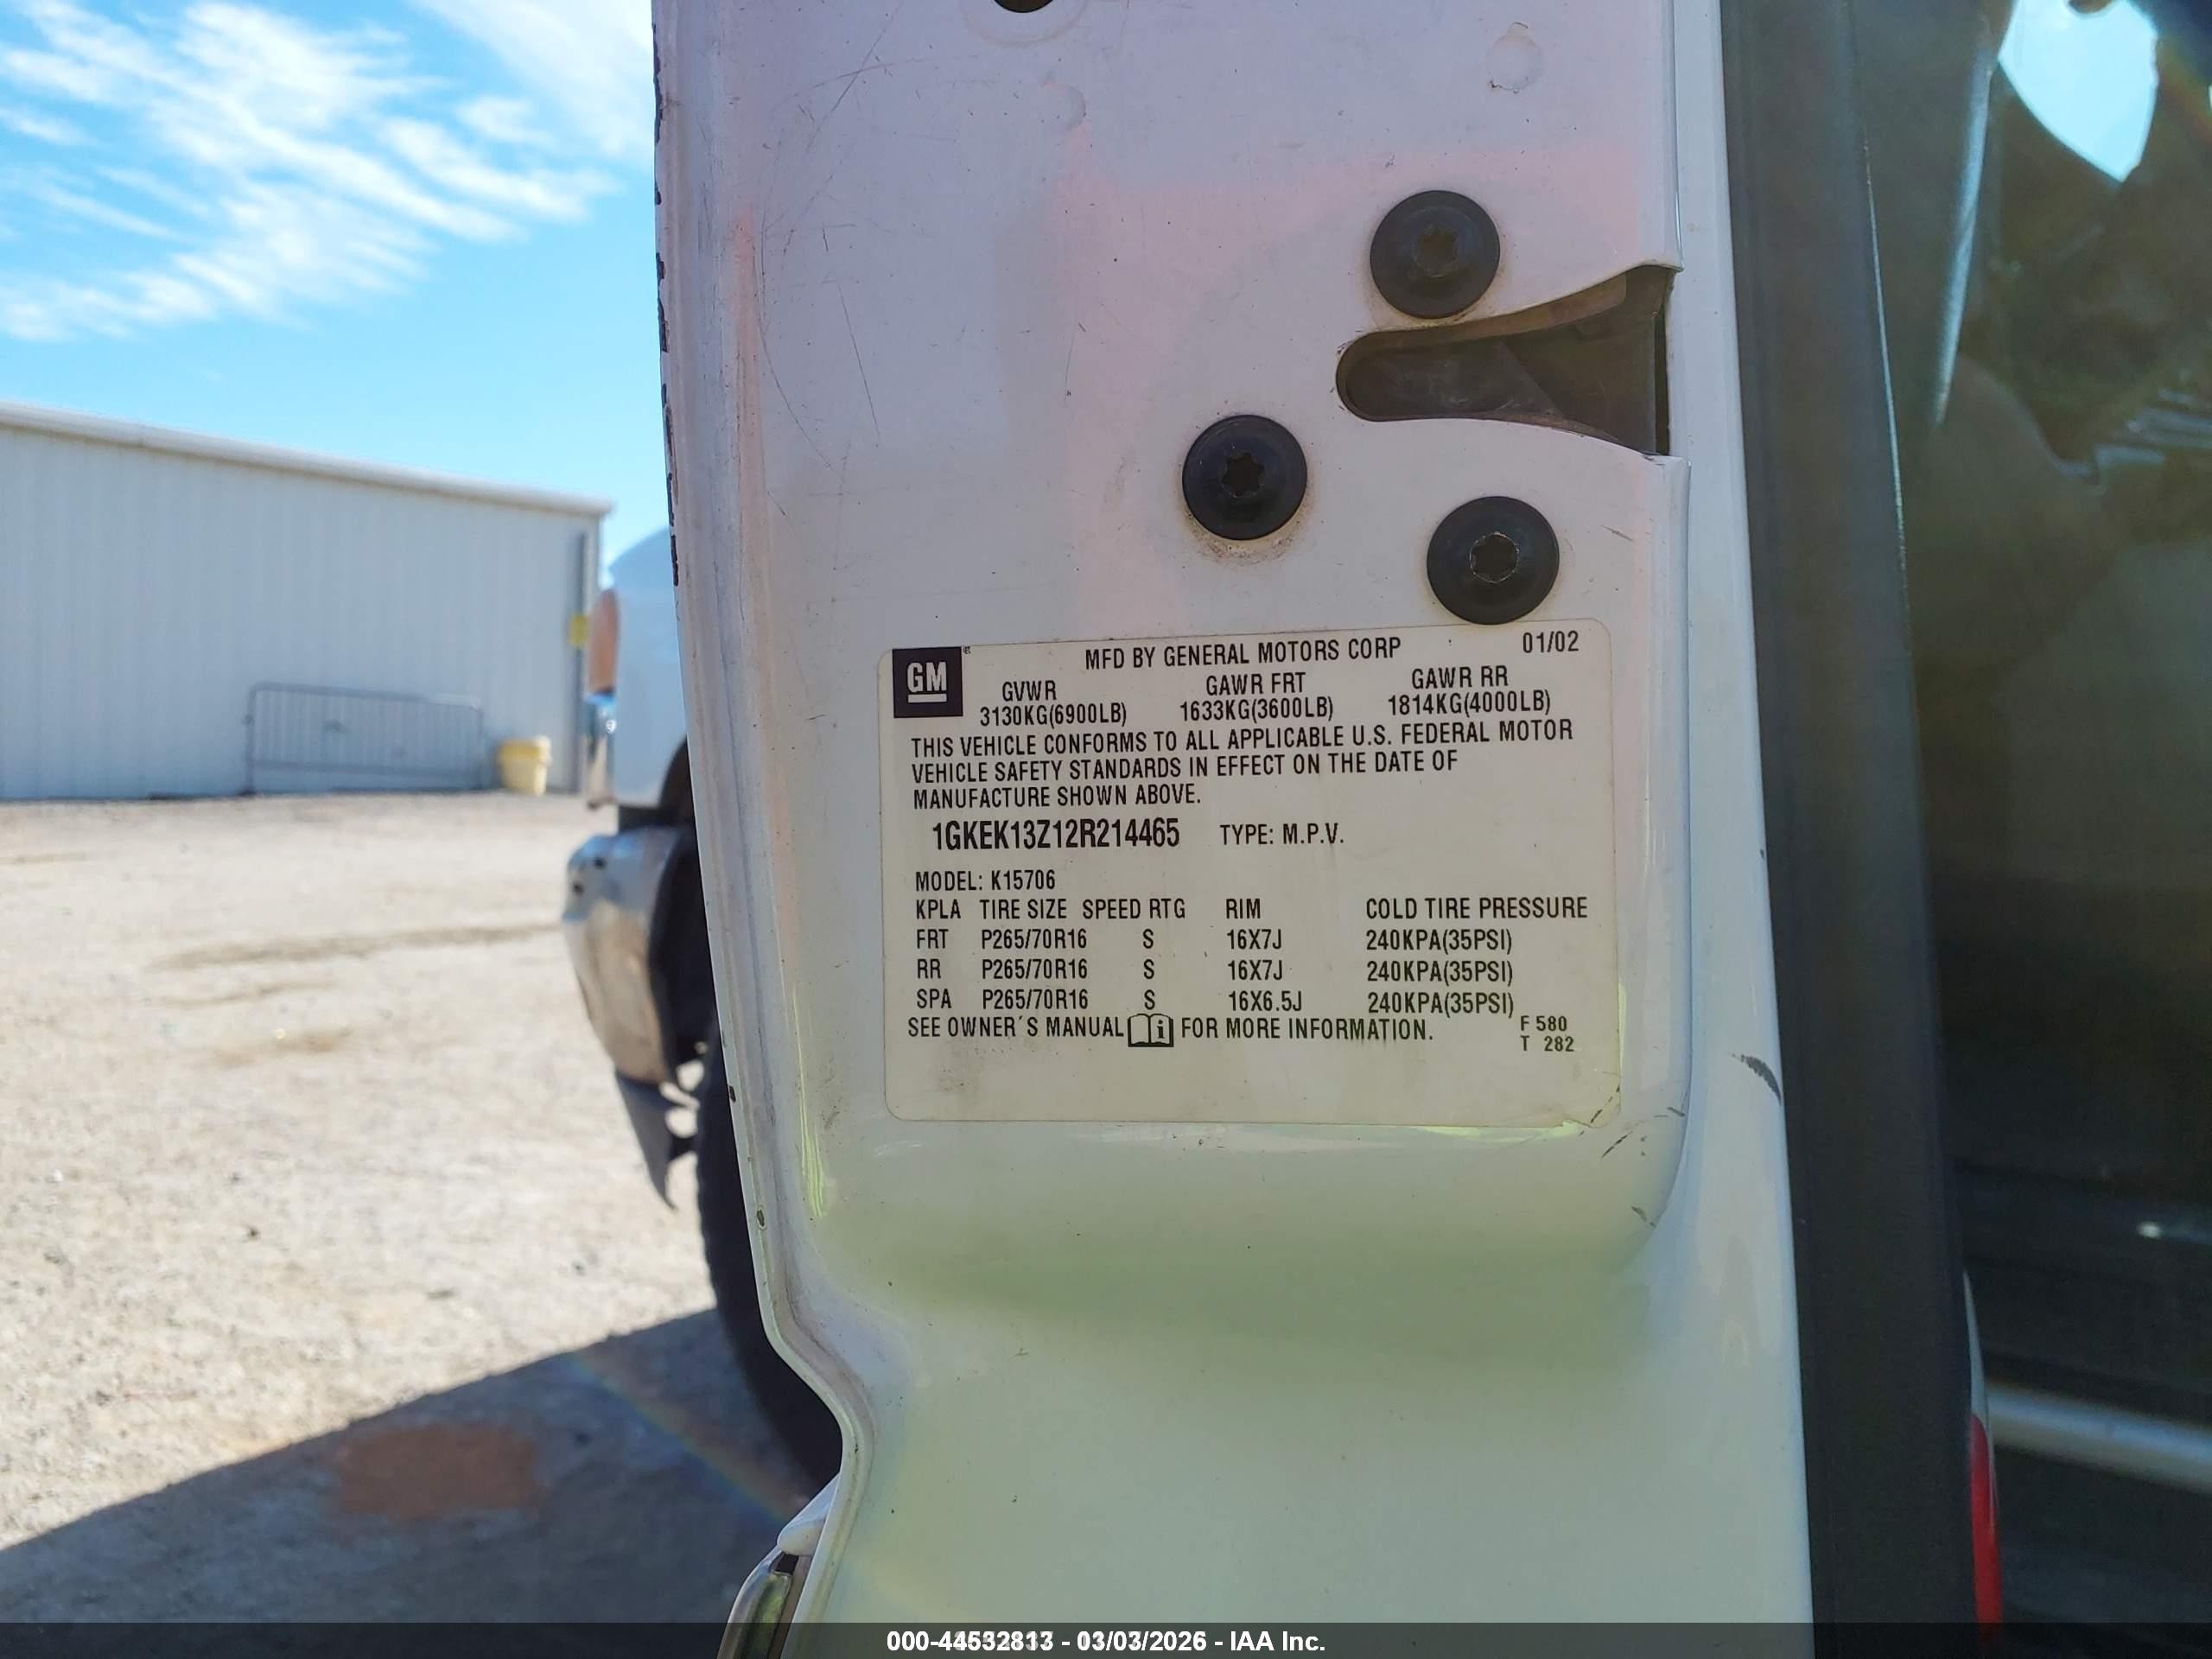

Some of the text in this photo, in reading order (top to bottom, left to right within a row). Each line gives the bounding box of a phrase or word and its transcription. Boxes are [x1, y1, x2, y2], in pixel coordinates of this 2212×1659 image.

[1522, 630, 1580, 653] 01/02
[1085, 637, 1401, 670] MFD BY GENERAL MOTORS CORP
[906, 661, 947, 692] GM
[1206, 672, 1306, 696] GAWR FRT
[1412, 665, 1509, 690] GAWR RR
[1002, 680, 1057, 701] GVWR
[1179, 696, 1333, 723] 1633KG(3600LB)
[1388, 690, 1551, 716] 1814KG(4000LB)
[980, 702, 1127, 728] 3130KG(6900LB)
[912, 719, 1573, 758] THIS VEHICLE CONFORMS TO ALL APPLICABLE U.S. FEDERAL MOTOR
[912, 750, 1458, 784] VEHICLE SAFETY STANDARDS IN EFFECT ON THE DATE OF
[913, 784, 1201, 809] MANUFACTURE SHOWN ABOVE.
[932, 817, 1179, 850] 1GKEK13Z12R214465
[1220, 823, 1344, 845] TYPE: M.P.V.
[915, 870, 1056, 892] MODEL: K15706
[916, 899, 961, 919] KPLA
[980, 899, 1067, 919] TIRE SIZE
[1082, 898, 1185, 919] SPEED RTG
[1226, 898, 1261, 919] RIM
[1366, 897, 1588, 919] COLD TIRE PRESSURE
[916, 930, 949, 950] FRT
[981, 929, 1087, 950] P265/70R16
[1142, 929, 1154, 950] S
[1226, 929, 1282, 950] 16X7J
[1366, 929, 1512, 955] 240KPA(35PSI)
[917, 960, 941, 979] RR
[982, 959, 1088, 979] P265/70R16
[1143, 959, 1154, 980] S
[1227, 959, 1283, 981] 16X7J
[1367, 961, 1513, 986] 240KPA(35PSI)
[916, 989, 951, 1009] SPA
[982, 989, 1089, 1009] P265/70R16
[1144, 989, 1155, 1010] S
[1228, 989, 1302, 1012] 16X6.5J
[1368, 992, 1514, 1018] 240KPA(35PSI)
[908, 1017, 940, 1037] SEE
[1046, 1017, 1123, 1037] MANUAL
[1181, 1018, 1217, 1039] FOR
[1226, 1018, 1281, 1039] MORE
[1289, 1018, 1433, 1040] INFORMATION.
[1521, 1015, 1567, 1032] F 580
[1521, 1036, 1574, 1052] T 282
